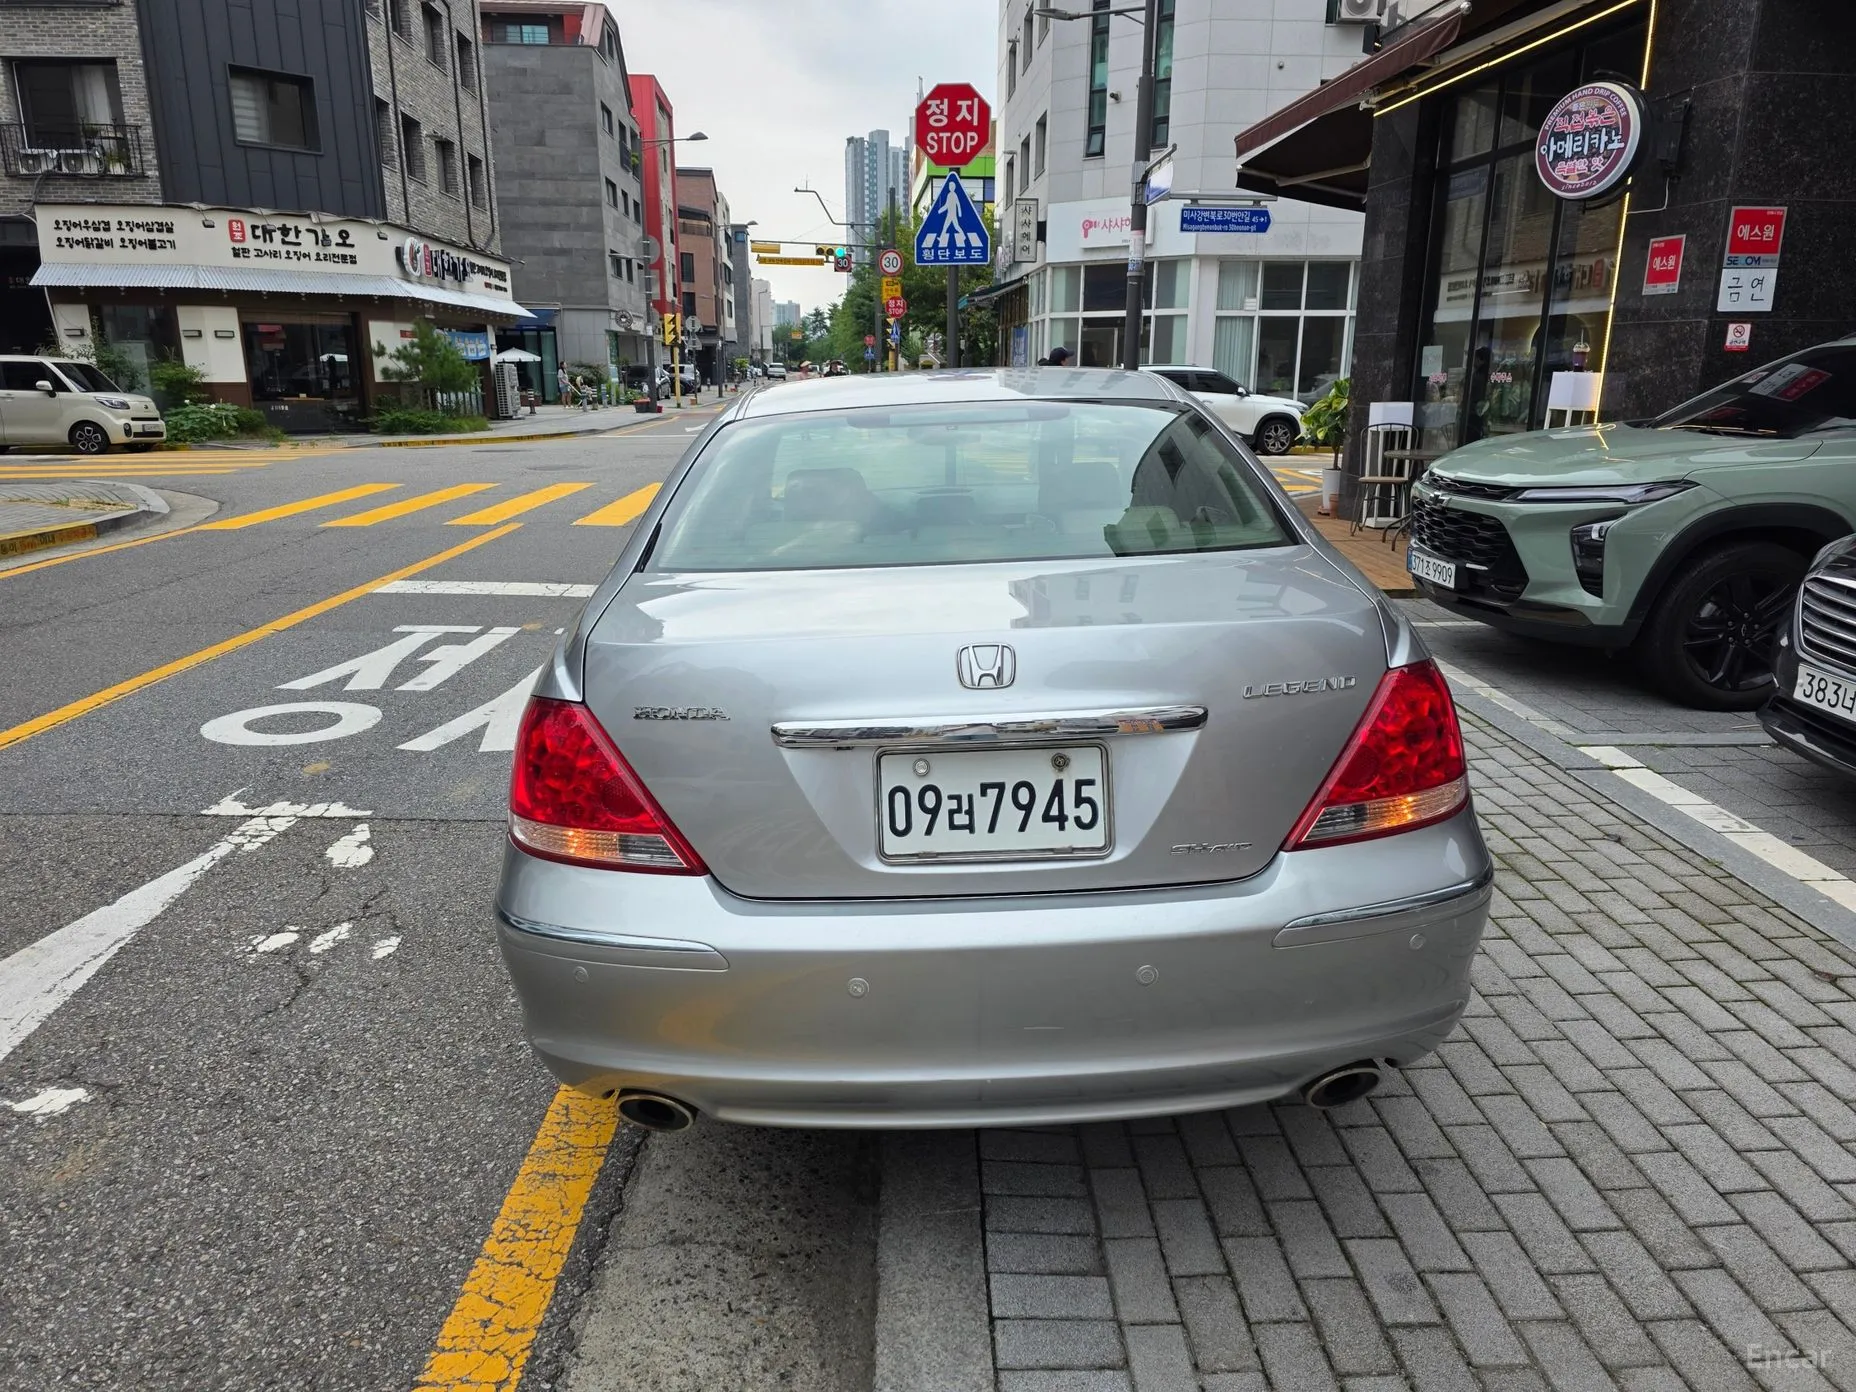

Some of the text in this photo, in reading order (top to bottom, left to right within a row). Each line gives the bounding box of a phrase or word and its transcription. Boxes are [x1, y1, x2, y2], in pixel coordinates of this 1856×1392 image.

[925, 97, 979, 127] 정지
[1544, 97, 1573, 131] PREMIUM
[1571, 87, 1595, 100] HAND
[1594, 87, 1612, 97] DRIP
[1609, 93, 1628, 118] COFFEE
[1554, 105, 1617, 134] 직접볶은
[926, 131, 979, 154] STOP
[1540, 127, 1625, 162] 아메리카노
[1554, 158, 1589, 176] 특별한
[1101, 216, 1132, 233] 샤샤
[1183, 210, 1251, 223] 미사강변북로30번안길
[54, 219, 175, 234] 오징어우삼겹 오징어삼겹살
[1737, 223, 1776, 241] 에스원
[56, 236, 177, 251] 오징어닭갈비 오징어불고기
[253, 248, 282, 261] 고사리
[284, 249, 312, 262] 오징어
[314, 251, 358, 265] 요리전문점
[837, 258, 849, 267] 30
[884, 256, 899, 268] 30
[921, 248, 984, 261] 횡단보도
[1652, 254, 1677, 272] 에스원
[1727, 275, 1765, 303] 금연
[888, 307, 904, 315] STOP
[1242, 675, 1357, 700] LEGEND
[633, 705, 731, 721] HONDA
[887, 778, 1100, 838] 09러7945
